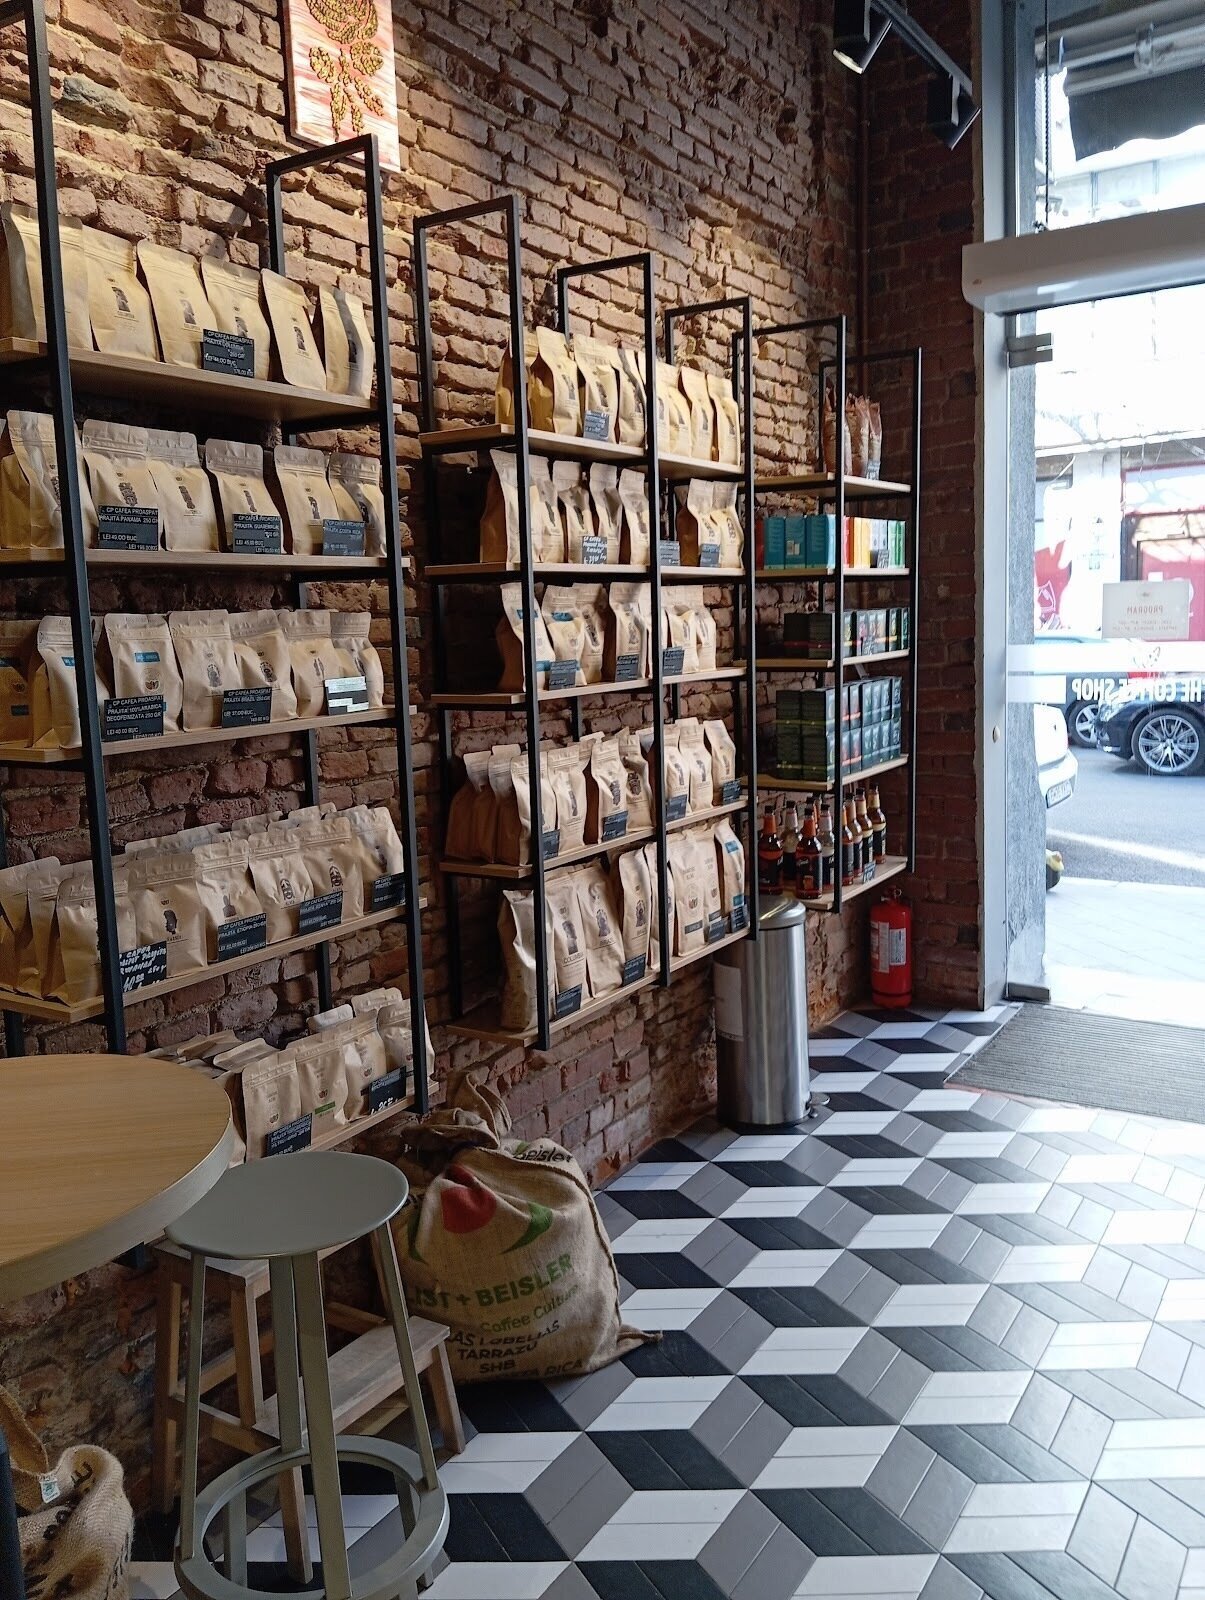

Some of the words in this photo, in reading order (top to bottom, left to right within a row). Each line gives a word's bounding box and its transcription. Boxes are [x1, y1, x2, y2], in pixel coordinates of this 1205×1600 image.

[475, 1253, 574, 1307] BEISLER
[480, 1315, 531, 1332] Coffee
[480, 1360, 515, 1374] SHB
